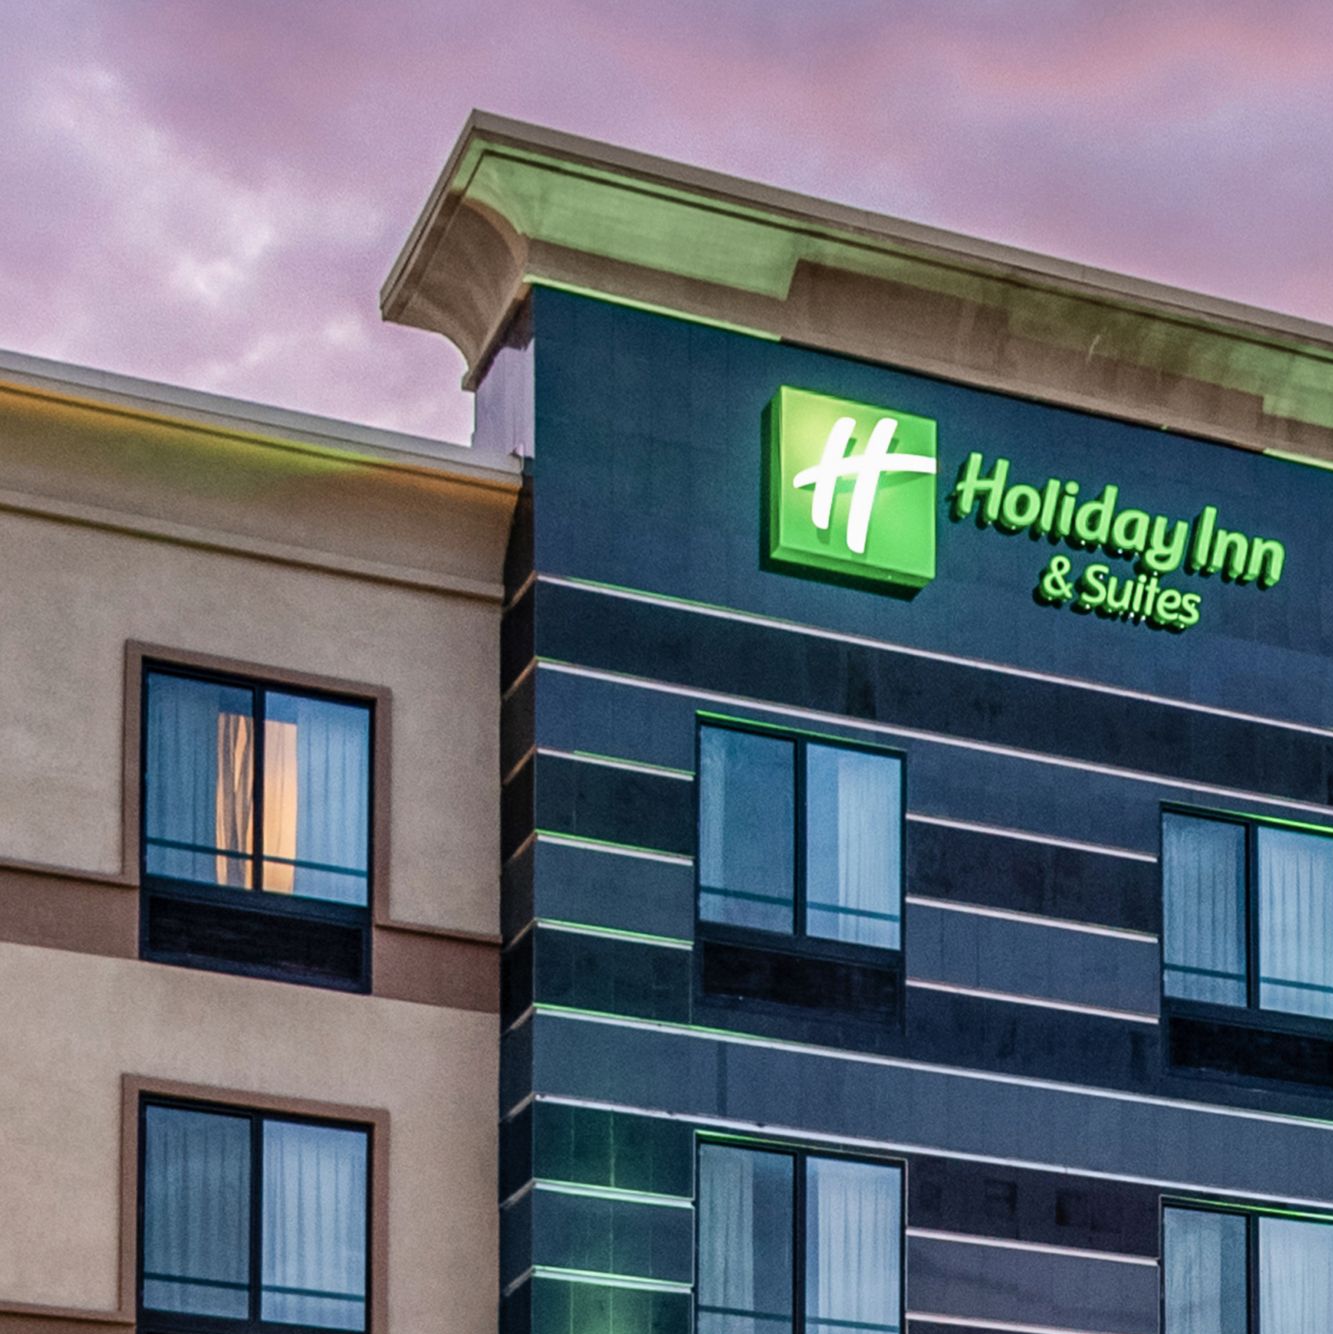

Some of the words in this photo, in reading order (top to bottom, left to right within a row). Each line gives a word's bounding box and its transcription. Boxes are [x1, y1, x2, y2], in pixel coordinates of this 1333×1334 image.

[956, 452, 1189, 573] Holiday
[1194, 506, 1285, 587] Inn
[1041, 554, 1074, 600] &
[1081, 564, 1201, 627] Suites
